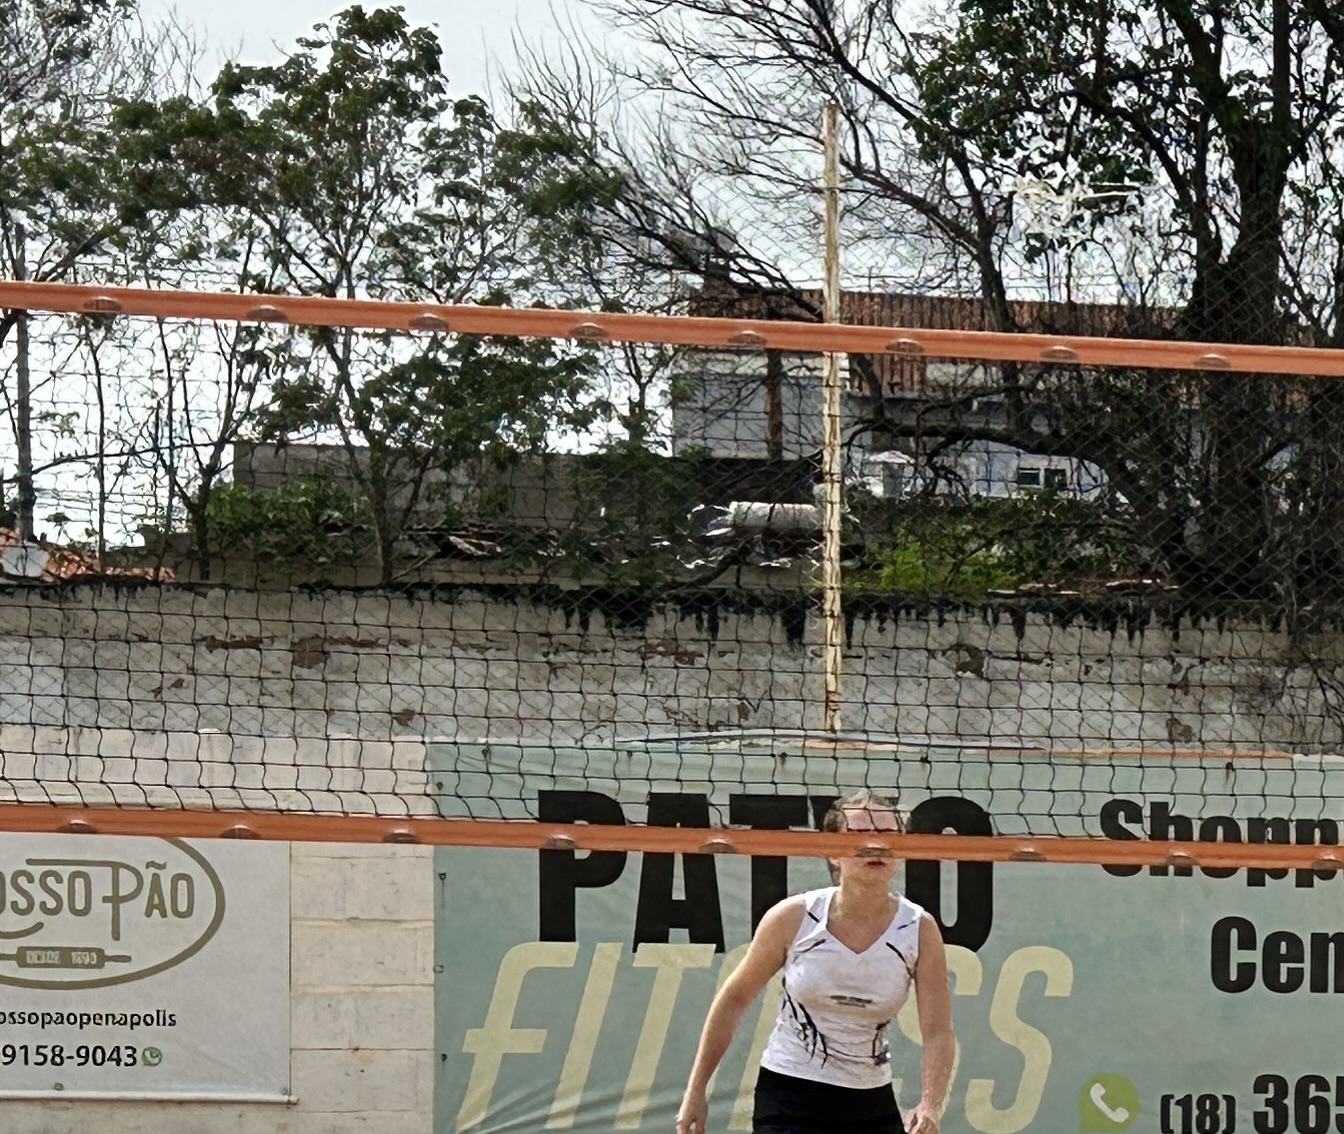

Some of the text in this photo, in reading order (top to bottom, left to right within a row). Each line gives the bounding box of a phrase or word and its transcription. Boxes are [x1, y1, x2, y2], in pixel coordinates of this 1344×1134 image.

[102, 858, 195, 941] PÃO
[538, 789, 993, 952] PATO
[1, 1044, 138, 1067] 9158-9043
[1160, 1094, 1236, 1134] (18)
